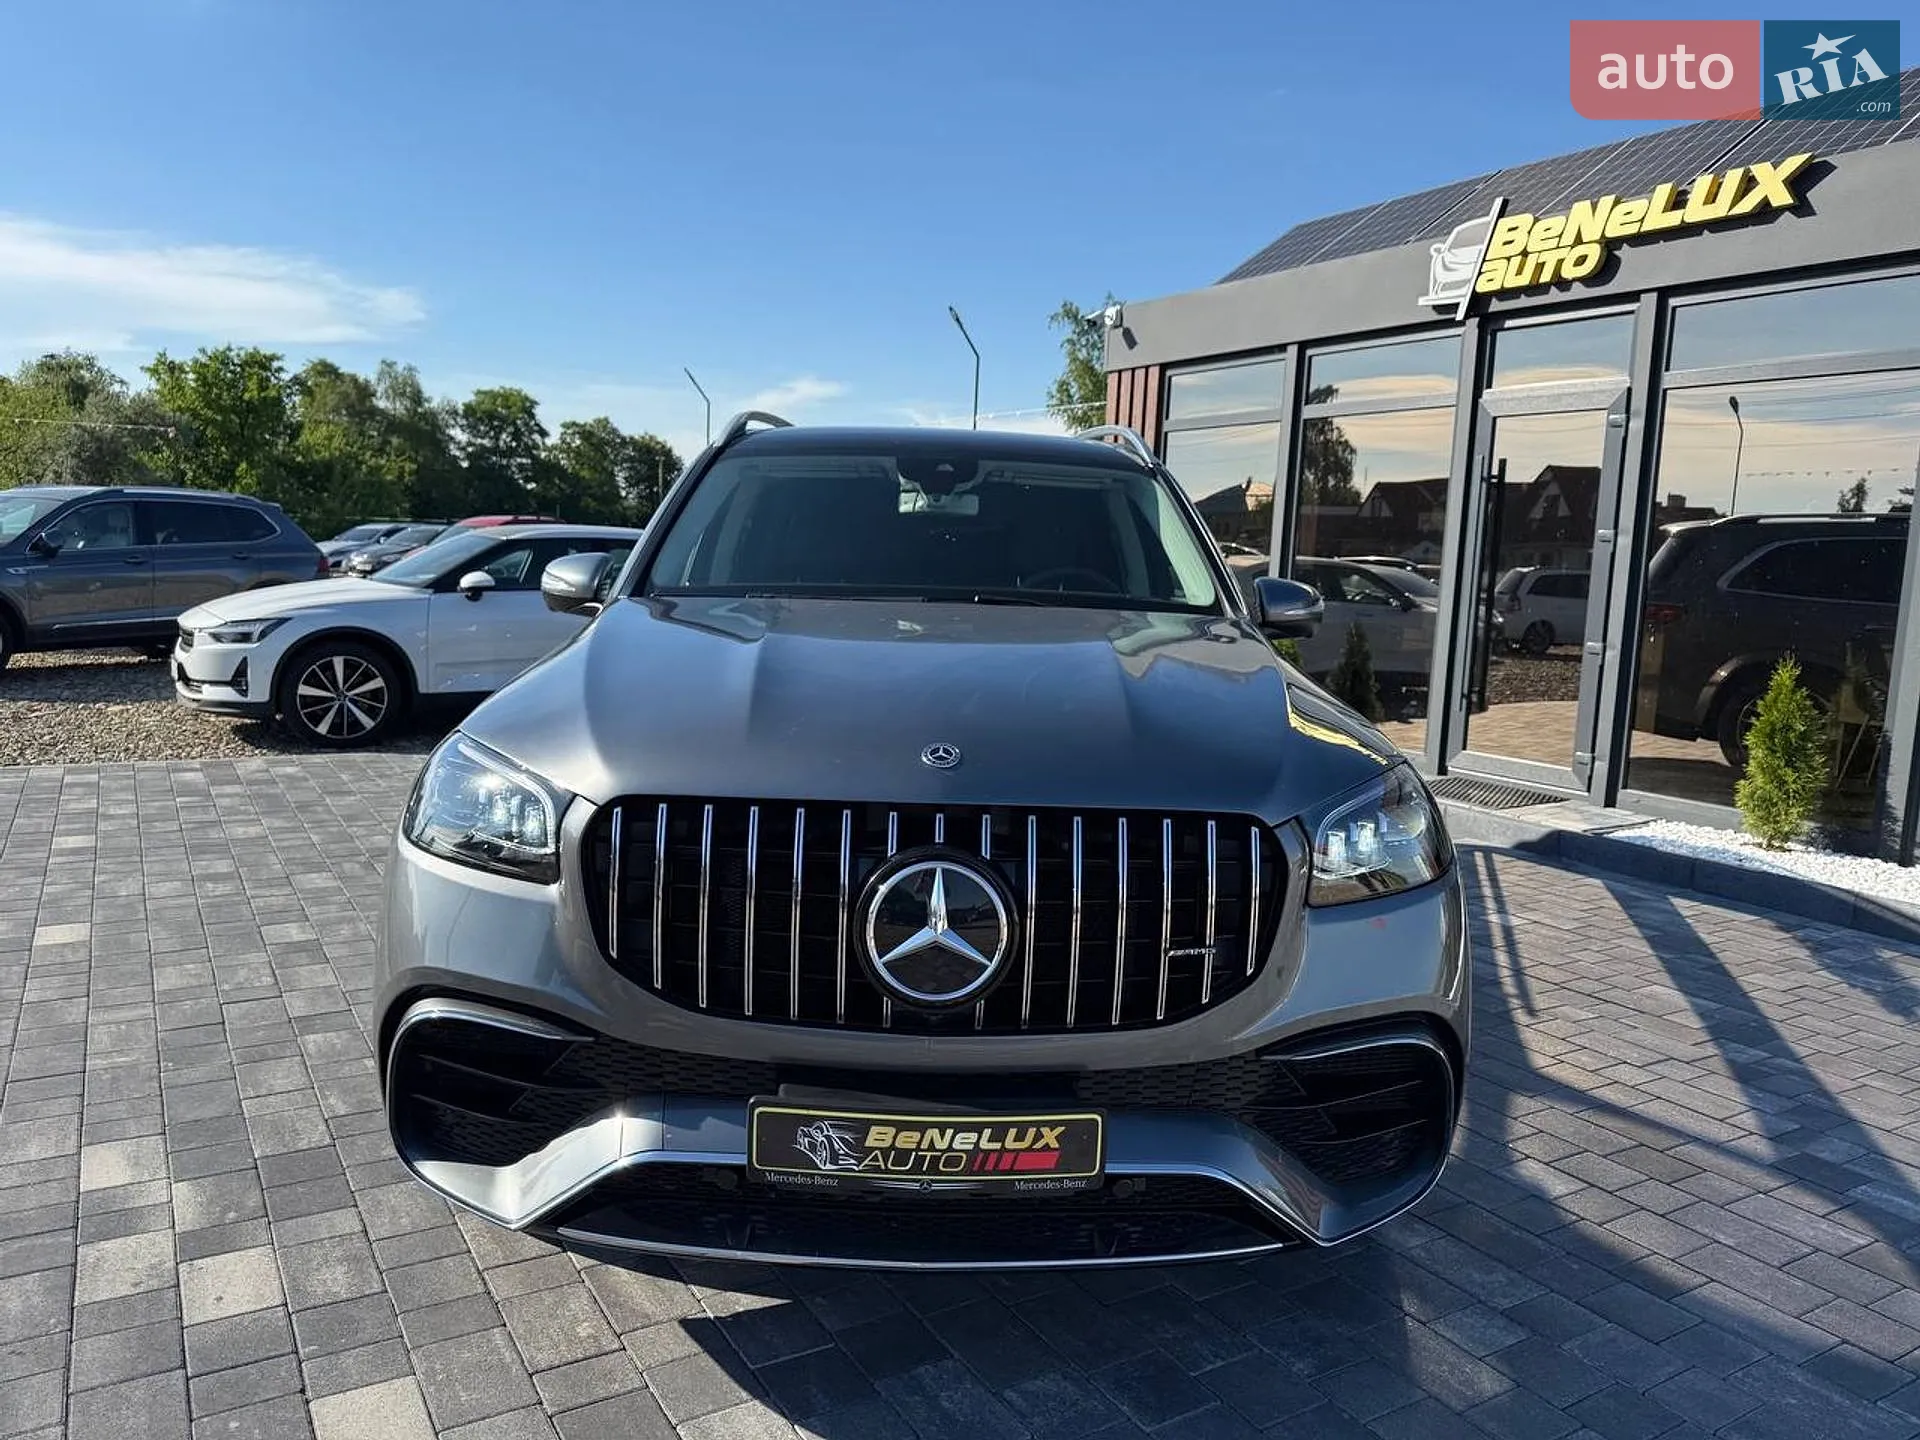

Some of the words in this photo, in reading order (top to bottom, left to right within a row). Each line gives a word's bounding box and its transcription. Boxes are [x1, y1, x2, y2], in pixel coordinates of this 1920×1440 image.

[1485, 152, 1815, 260] BeNeLUX
[864, 1125, 1066, 1150] BeNeLUX
[857, 1151, 967, 1172] AUTO
[765, 1172, 839, 1187] Mercedes-Benz
[1014, 1178, 1087, 1191] Mercedes-Benz
